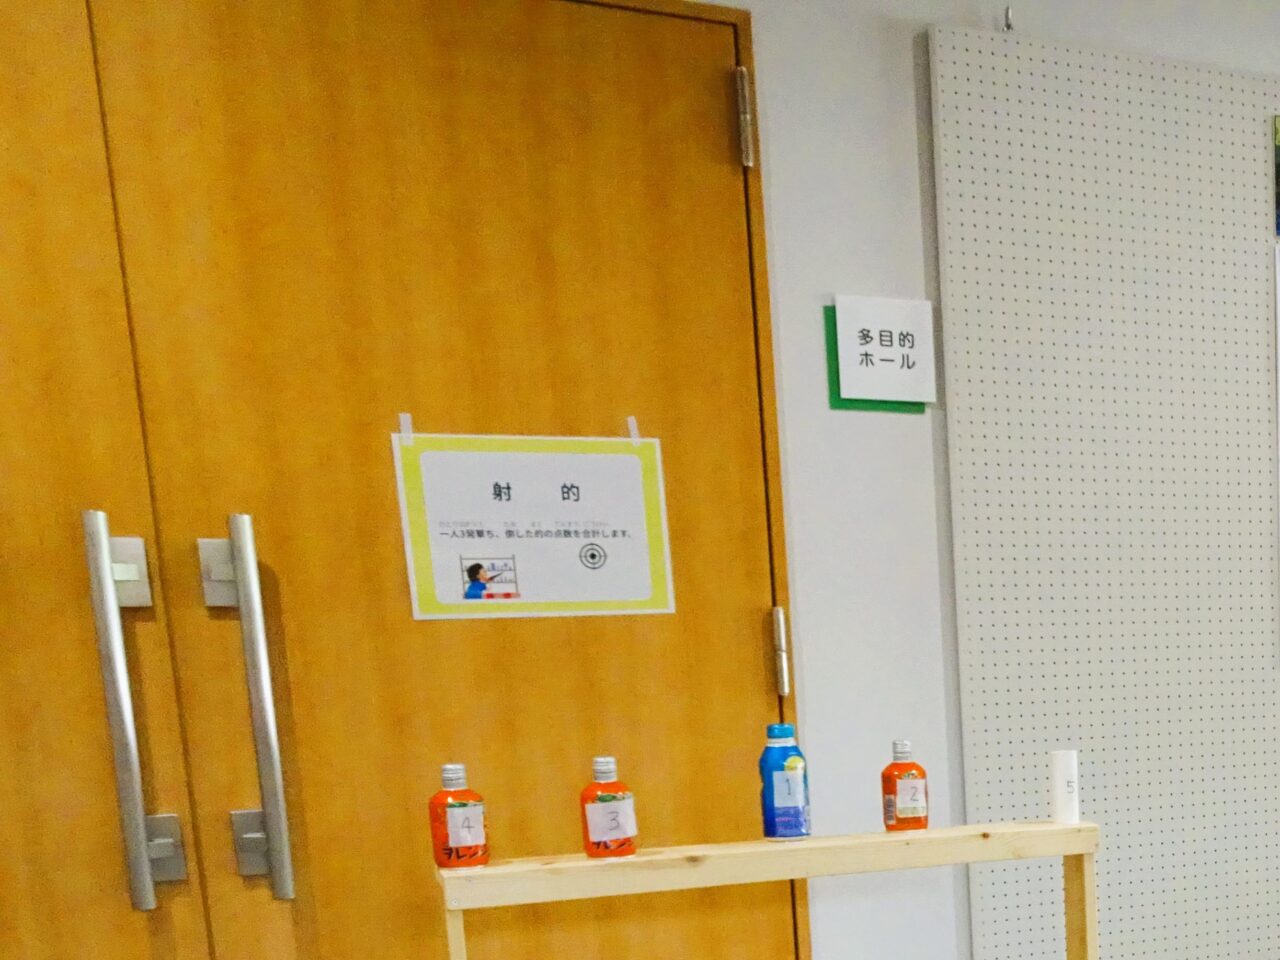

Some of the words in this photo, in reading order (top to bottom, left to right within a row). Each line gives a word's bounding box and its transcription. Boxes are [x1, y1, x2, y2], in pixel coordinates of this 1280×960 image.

[858, 328, 915, 349] 多目的
[859, 351, 916, 370] ホール
[493, 482, 512, 502] 射
[561, 483, 580, 502] 的
[910, 786, 919, 802] 2
[1066, 780, 1075, 794] 5
[461, 816, 476, 835] 4
[607, 811, 620, 831] 3
